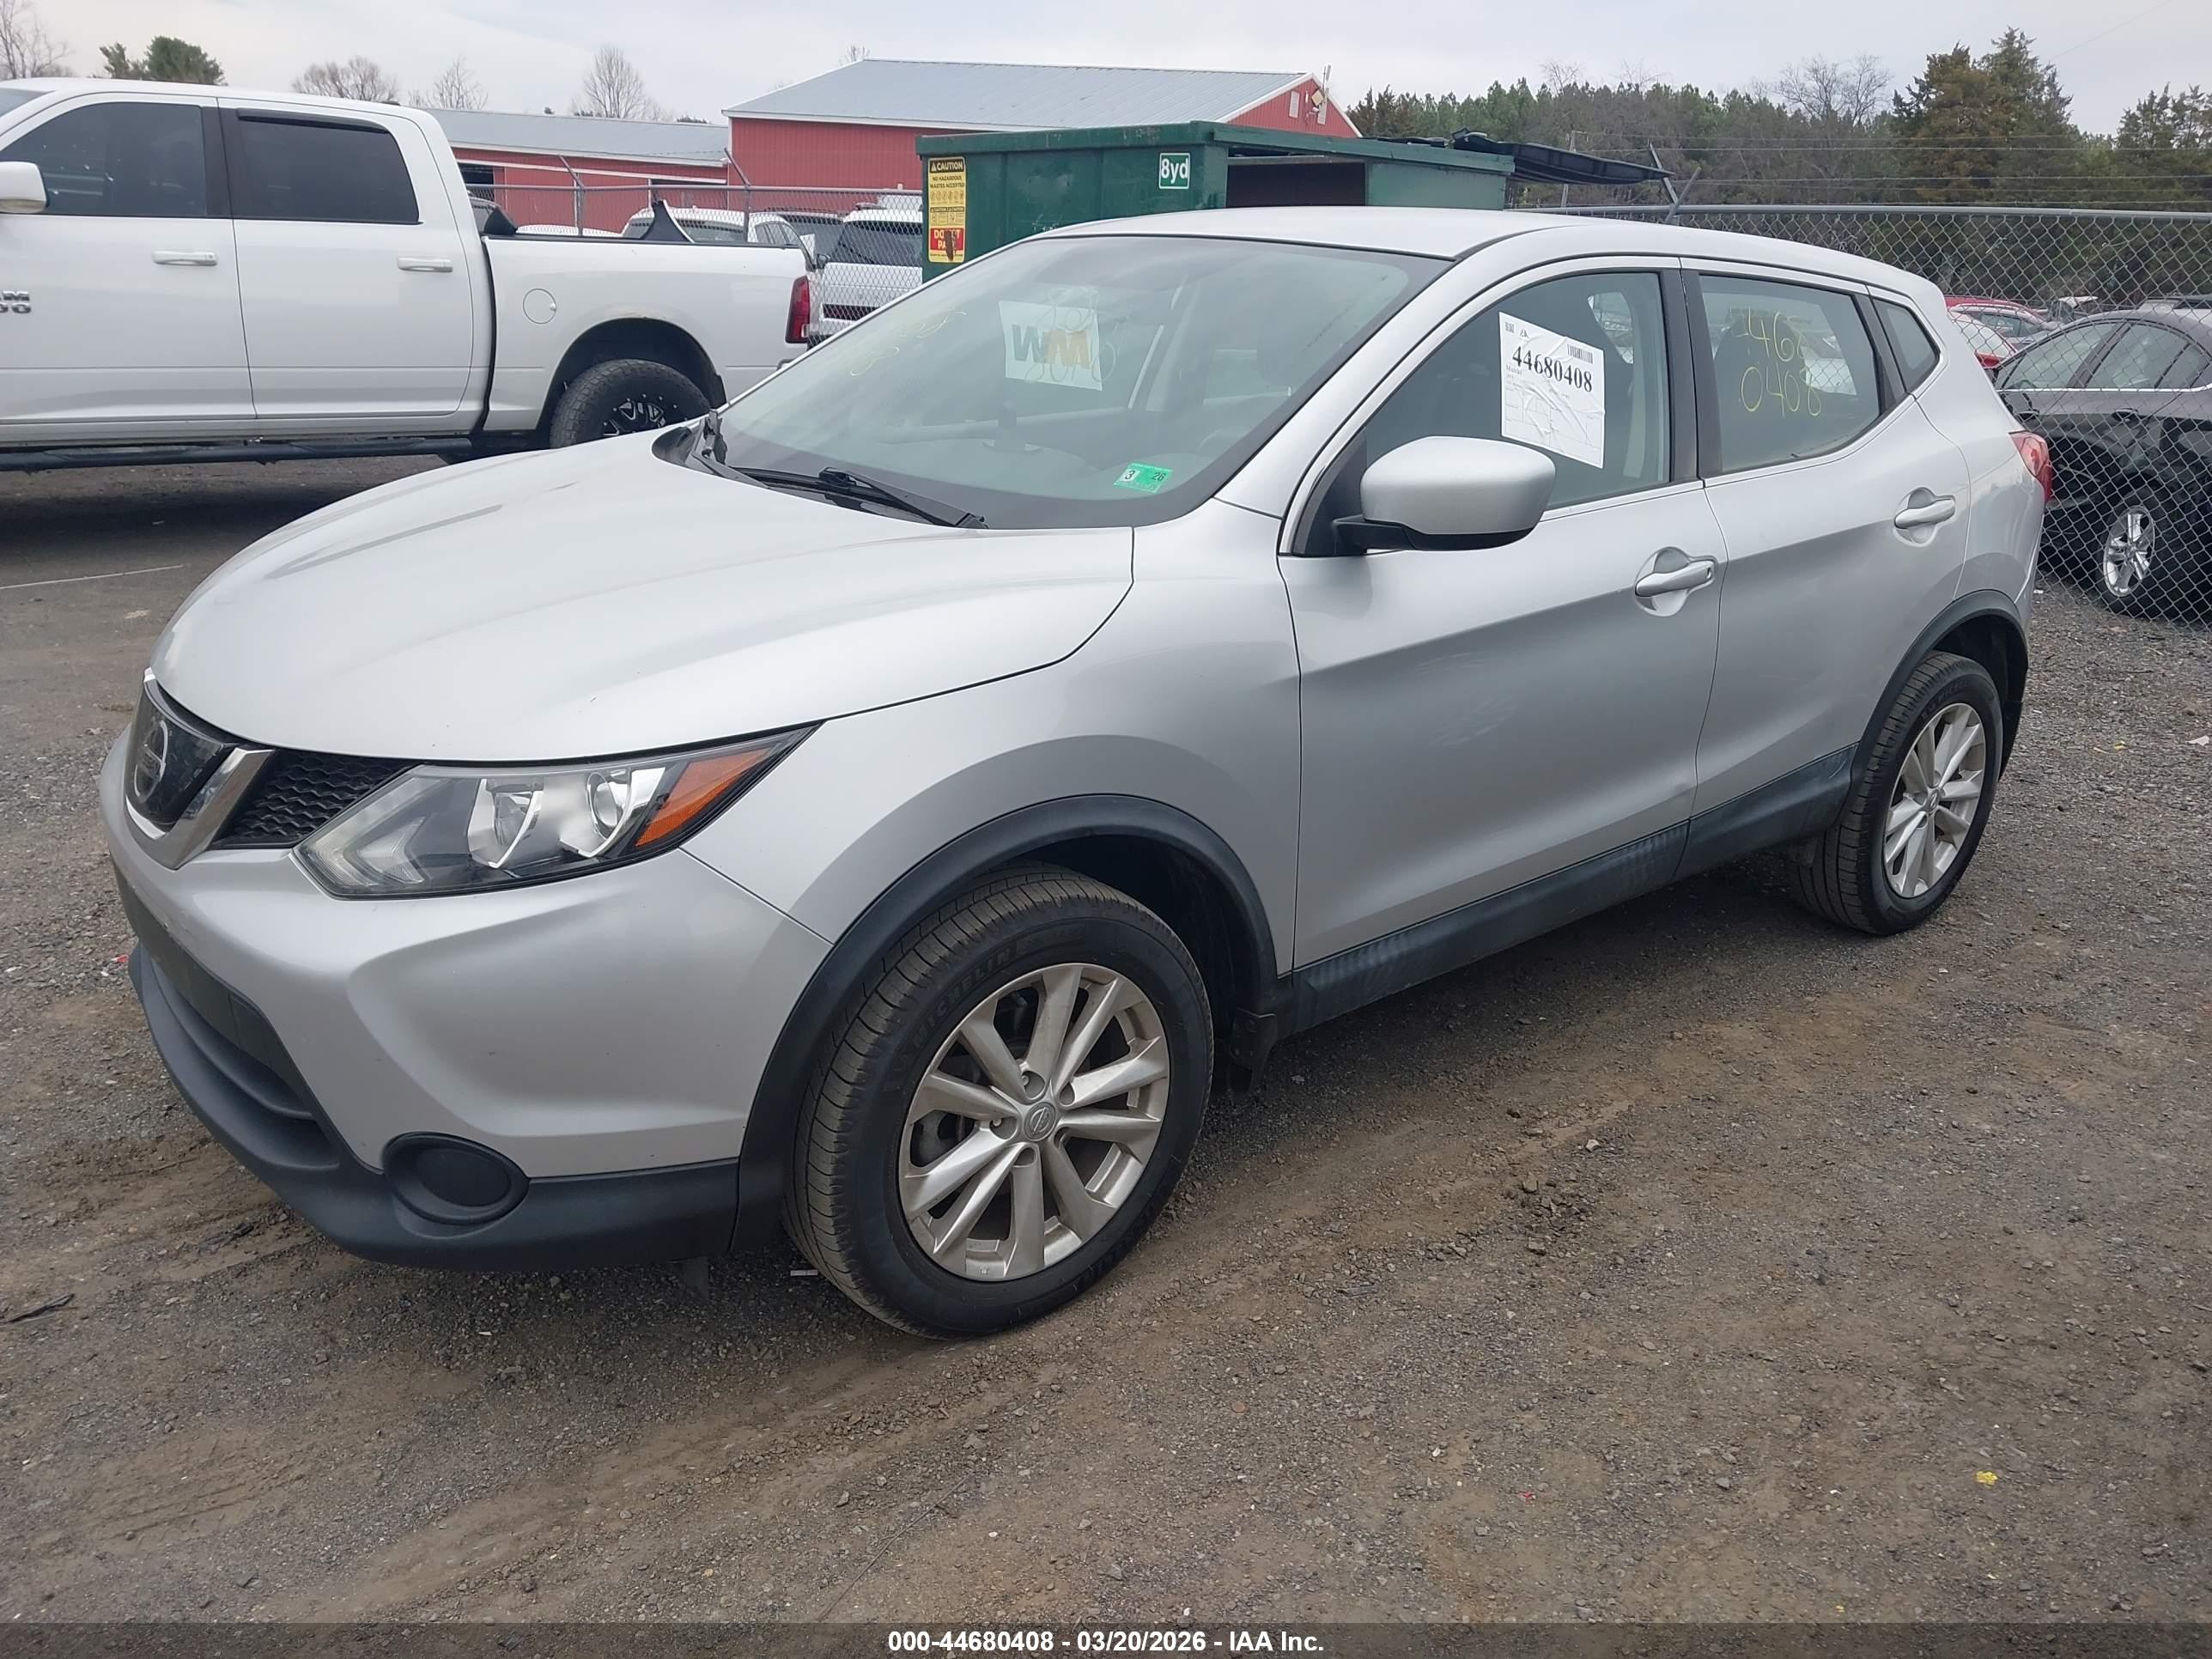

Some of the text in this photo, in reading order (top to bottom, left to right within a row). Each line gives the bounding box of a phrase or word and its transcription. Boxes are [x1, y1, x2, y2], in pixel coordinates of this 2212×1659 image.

[936, 161, 963, 171] CAUTION
[1161, 158, 1188, 184] 8yd
[933, 228, 961, 240] DO OT
[0, 291, 30, 301] M
[1012, 324, 1091, 370] WM
[1512, 345, 1592, 392] 44680408
[1741, 361, 1821, 418] 0408
[1124, 470, 1167, 482] 3 26
